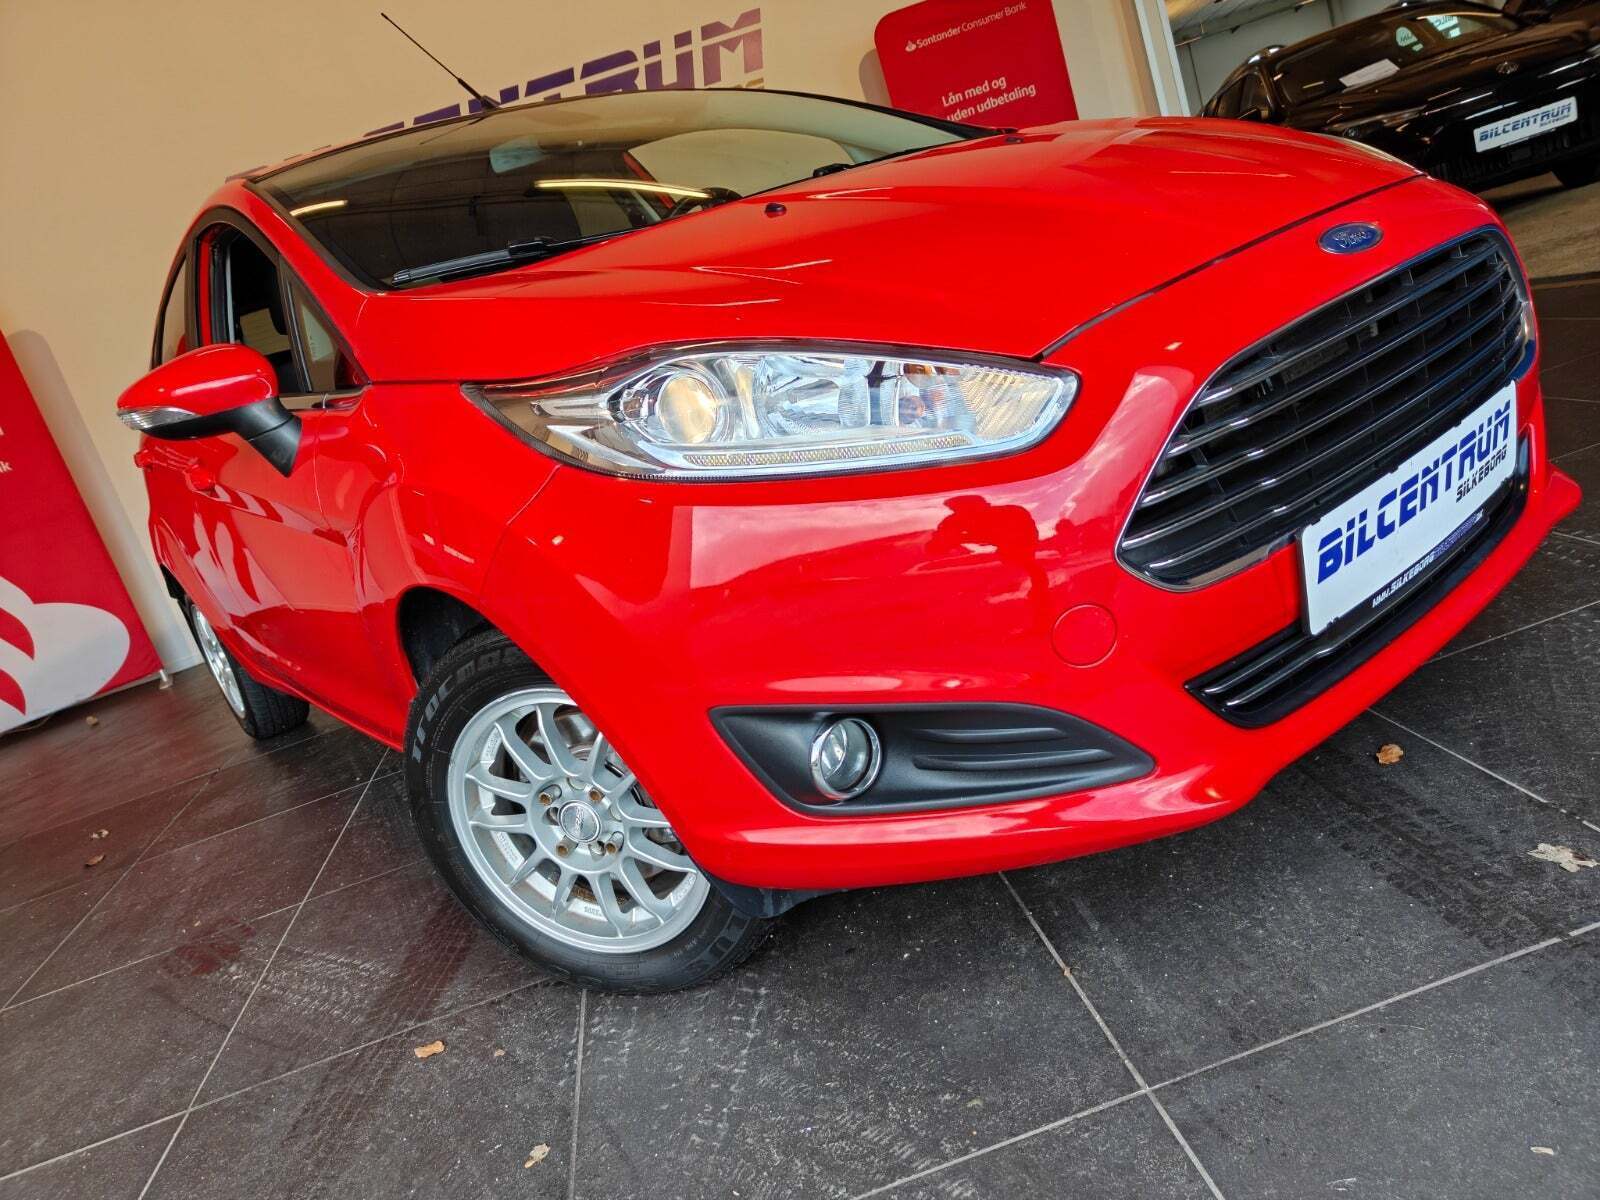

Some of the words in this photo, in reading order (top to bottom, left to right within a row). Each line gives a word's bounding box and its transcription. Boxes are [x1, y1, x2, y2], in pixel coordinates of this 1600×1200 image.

[916, 26, 962, 48] Santander
[961, 10, 1004, 33] Consumer
[1004, 1, 1027, 17] Bank
[941, 90, 963, 108] Lån
[964, 79, 990, 101] med
[991, 75, 1007, 90] og
[946, 104, 976, 122] uden
[976, 83, 1036, 112] udbetaling
[1479, 102, 1572, 141] BILCENTRUM
[1317, 400, 1511, 585] BILCENTRUM
[1455, 445, 1508, 503] SILKEBORG
